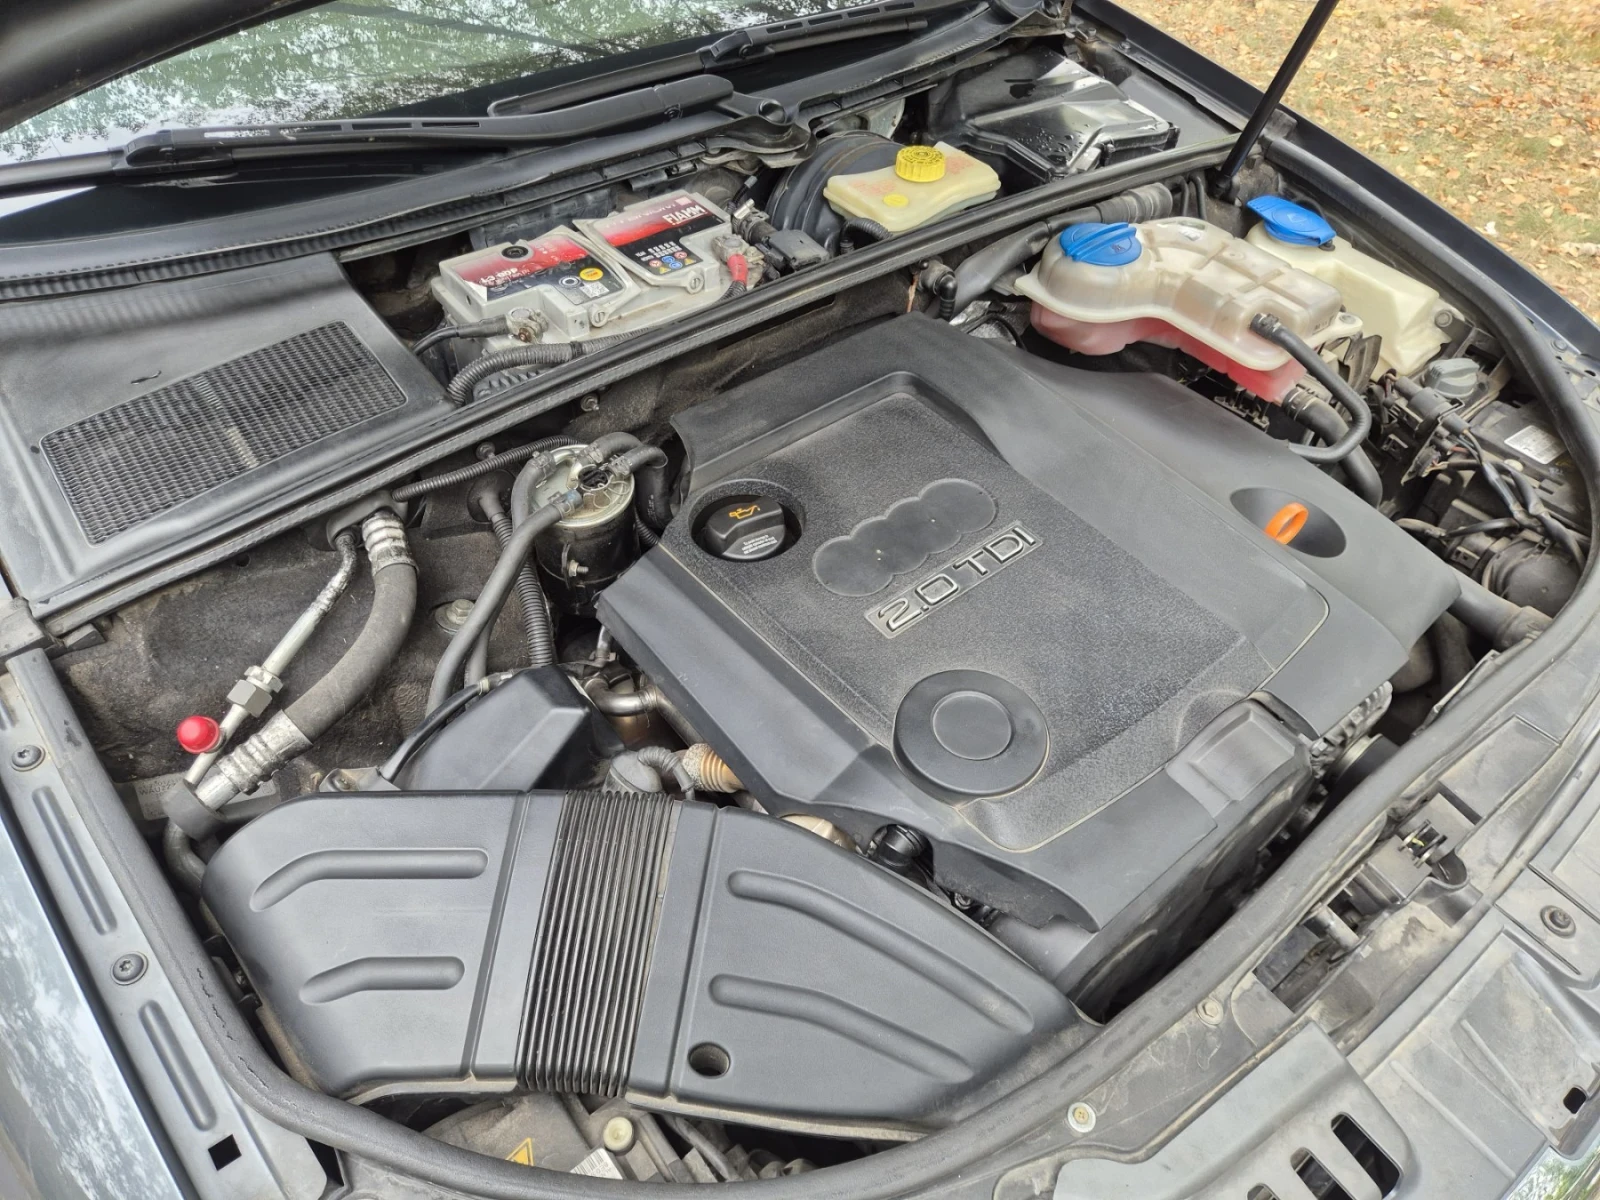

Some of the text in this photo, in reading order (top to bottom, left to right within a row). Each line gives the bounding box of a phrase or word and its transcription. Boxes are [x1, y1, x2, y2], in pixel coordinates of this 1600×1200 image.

[662, 204, 706, 225] FIAMM
[878, 527, 1036, 632] 2.0 TDI
